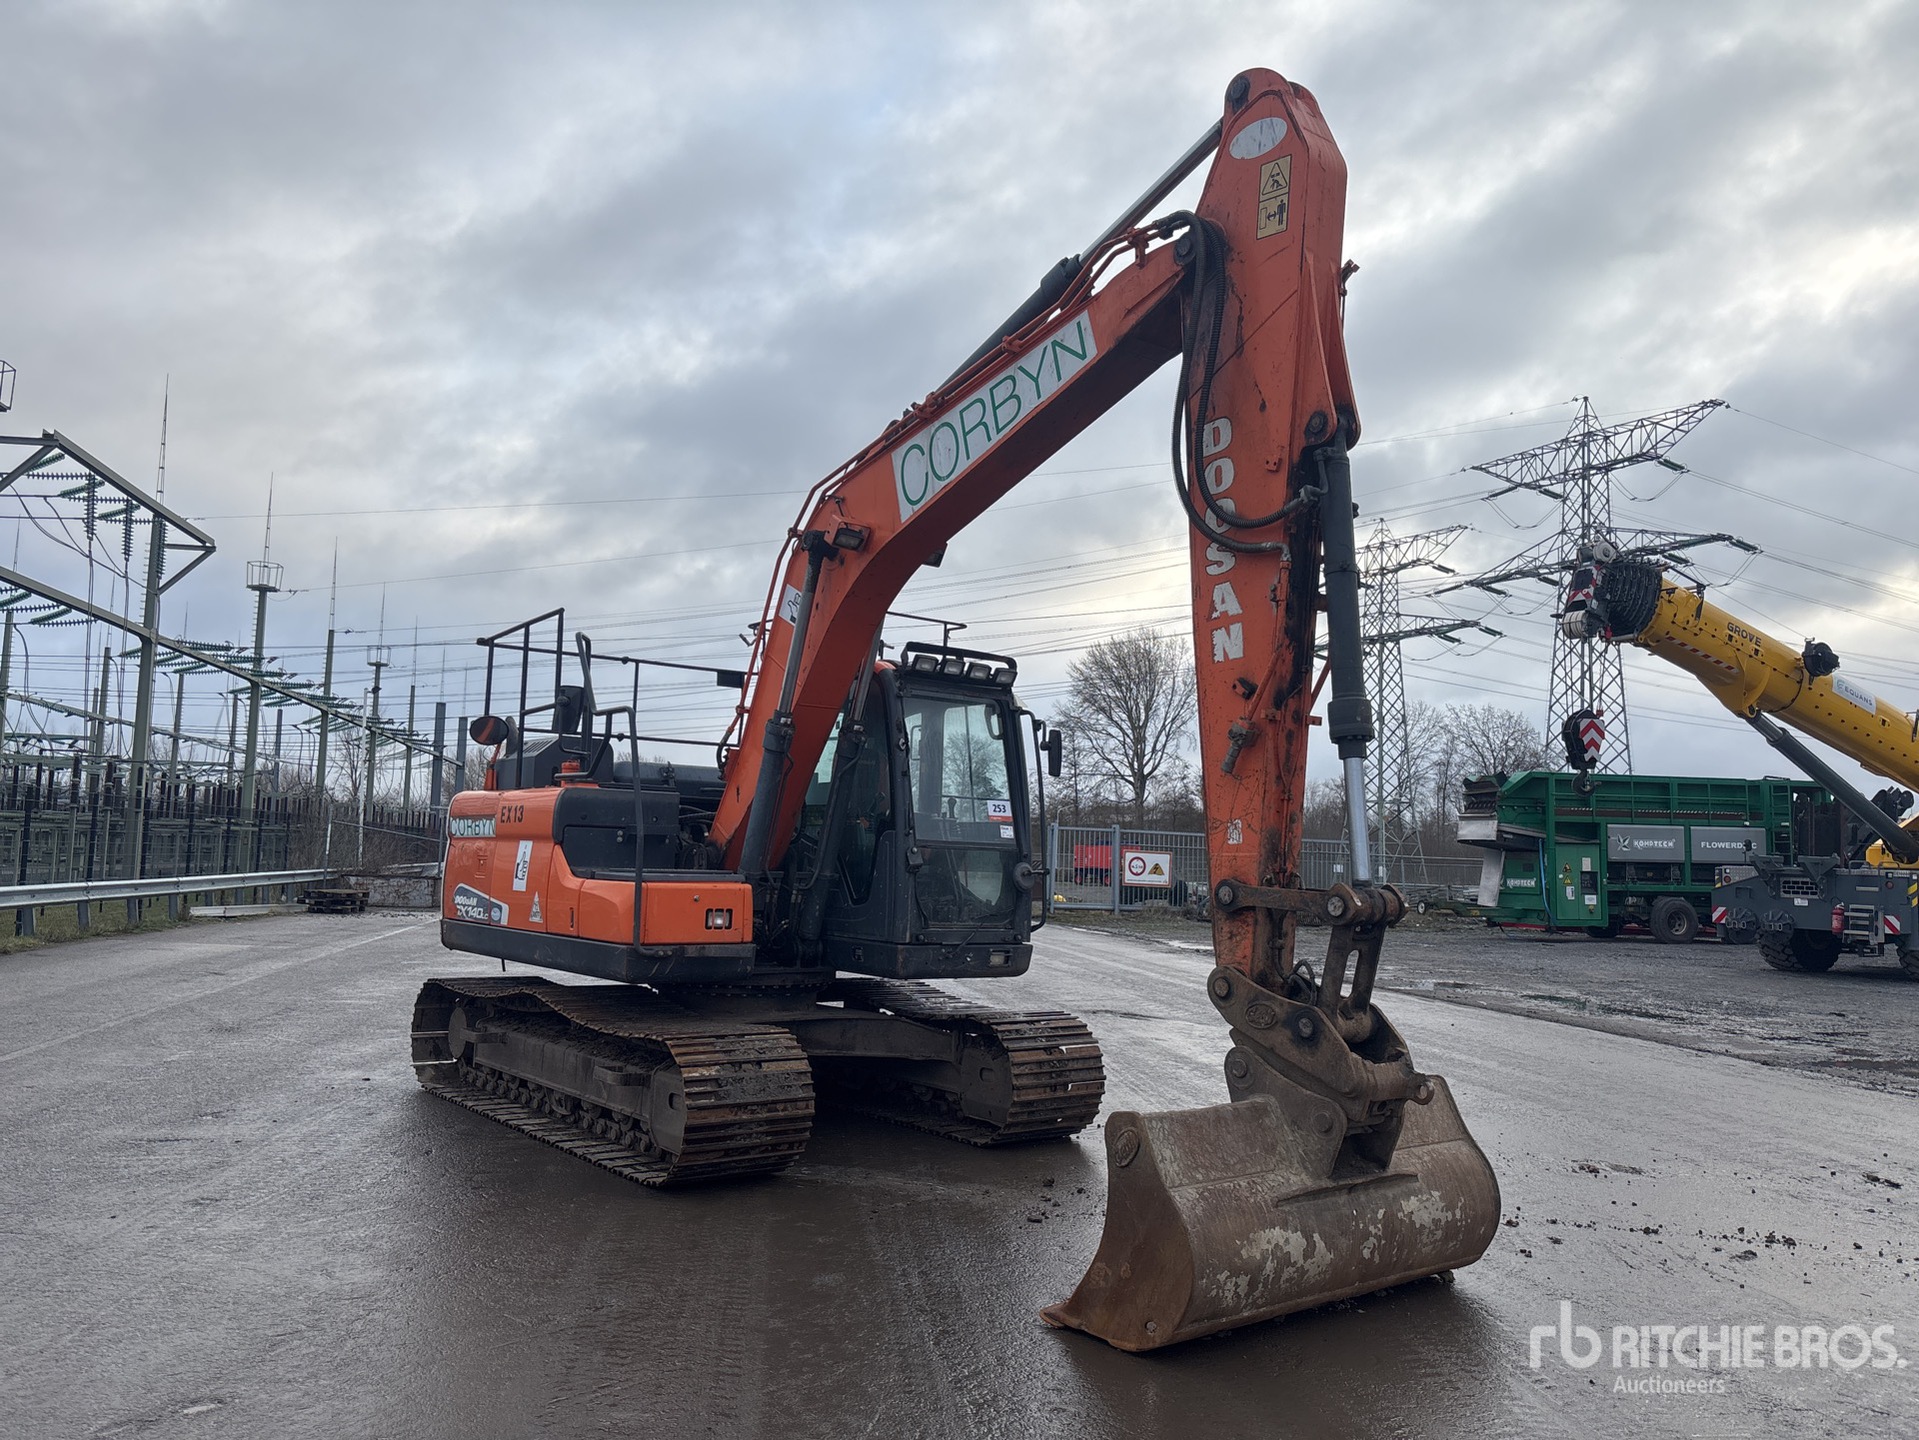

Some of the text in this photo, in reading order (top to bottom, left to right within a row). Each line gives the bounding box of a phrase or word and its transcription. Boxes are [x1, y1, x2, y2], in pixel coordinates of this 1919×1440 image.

[900, 320, 1088, 506] CORBYN
[1203, 416, 1244, 664] DOOSAN
[1727, 621, 1762, 647] GROVE
[1844, 685, 1873, 706] EQUANS
[992, 803, 1007, 813] 253
[451, 818, 495, 837] CORBYN
